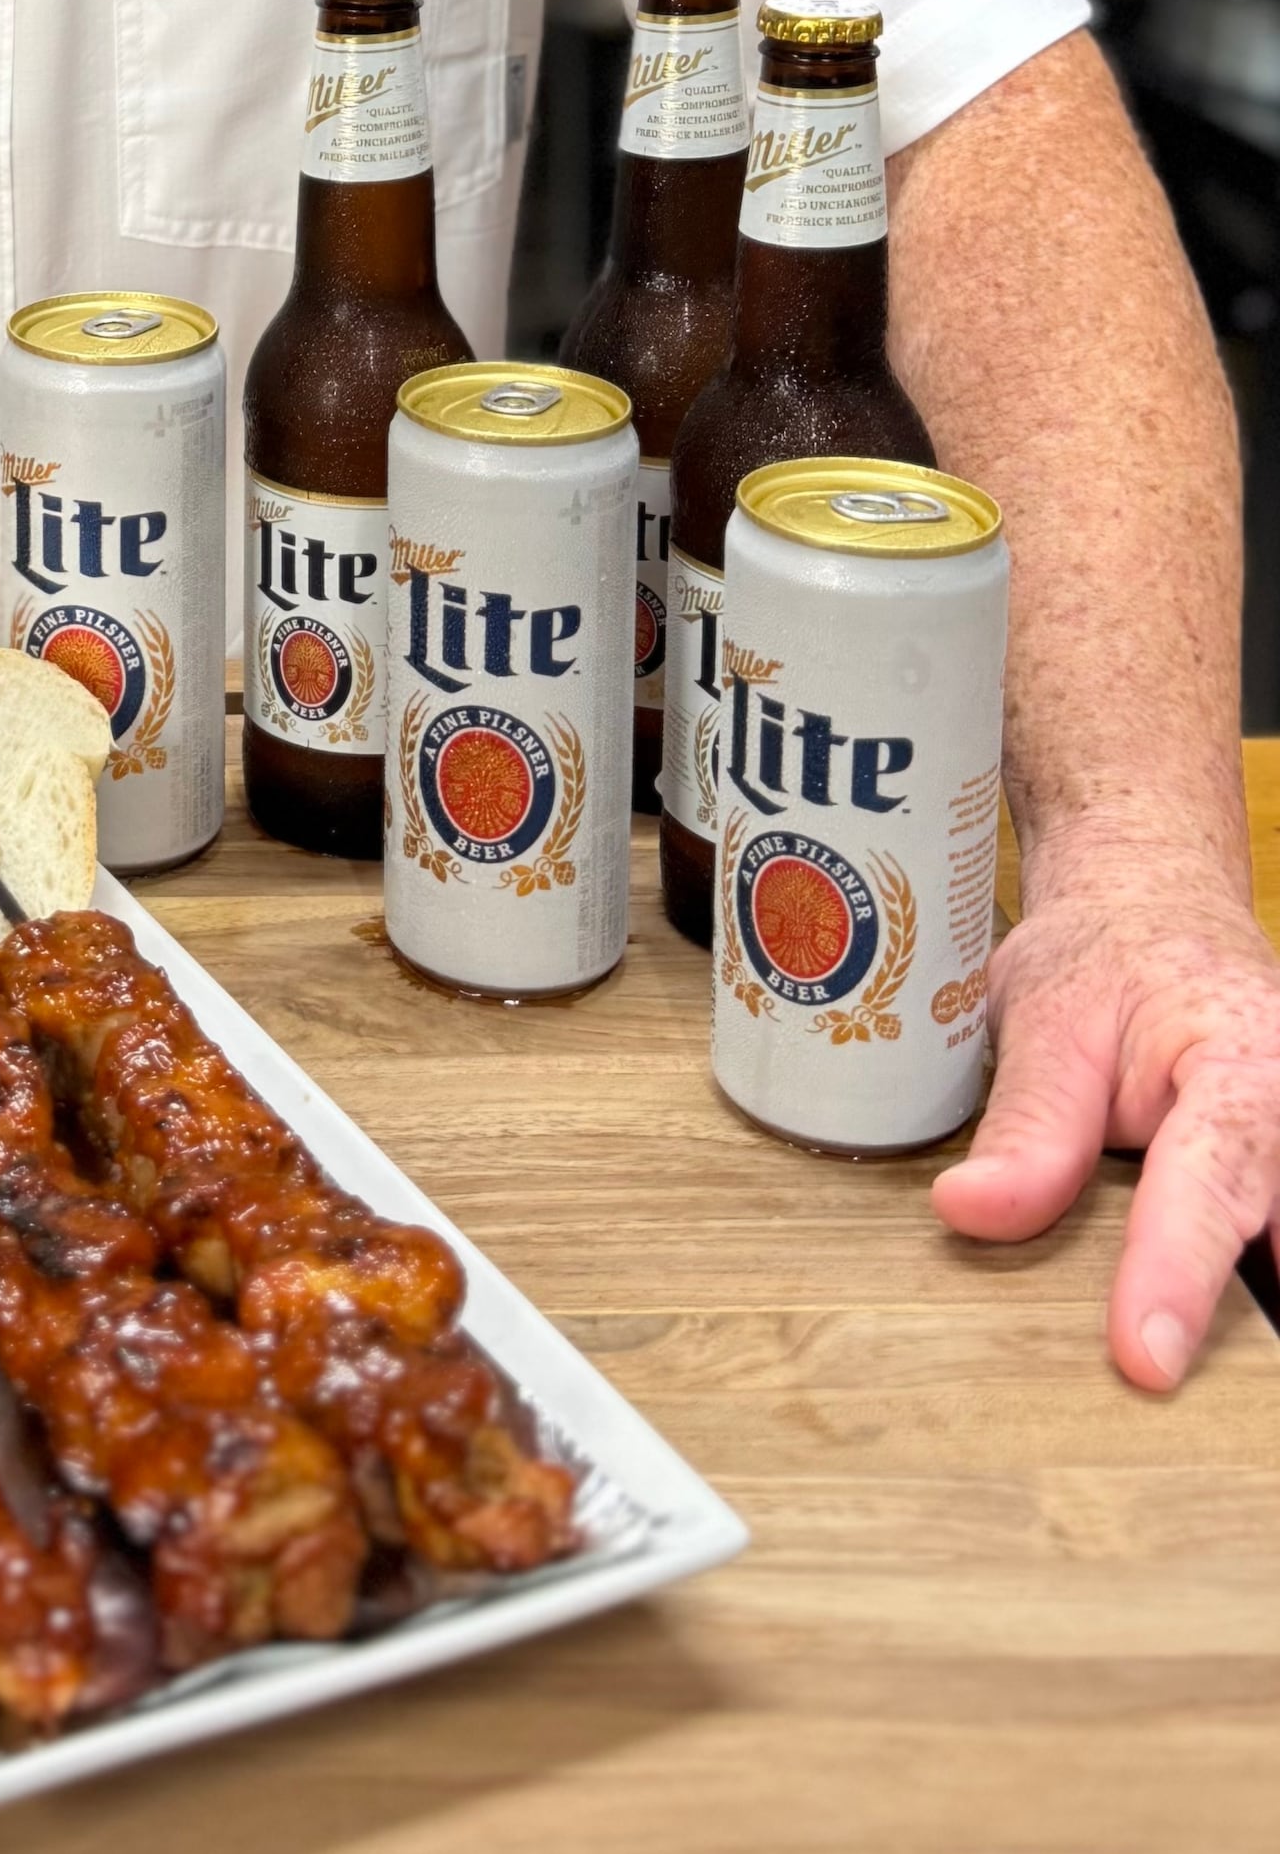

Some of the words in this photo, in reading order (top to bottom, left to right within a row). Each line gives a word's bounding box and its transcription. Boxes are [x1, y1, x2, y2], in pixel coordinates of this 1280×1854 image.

[319, 151, 377, 163] FREDRICK
[747, 122, 857, 184] Miller
[1, 449, 62, 489] Miller
[249, 496, 295, 525] Miller
[11, 477, 167, 595] Lite
[389, 529, 466, 580] Miller
[257, 517, 377, 611] Lite
[637, 586, 667, 627] LSNER
[675, 576, 724, 618] Mill
[33, 609, 69, 641] FINE
[75, 609, 140, 670] PILSNER
[276, 619, 300, 641] FINE
[303, 619, 349, 669] PILSNER
[403, 561, 581, 693] Lite
[272, 644, 281, 653] A
[722, 636, 784, 684] Miller
[291, 701, 327, 719] BEER
[430, 710, 472, 743] FINE
[424, 746, 437, 761] A
[478, 710, 550, 779] PILSNER
[727, 667, 914, 816] Lite
[453, 835, 515, 860] BEER
[746, 836, 787, 867] FINE
[741, 869, 753, 885] A
[794, 837, 872, 921] PILSNER
[766, 970, 831, 1000] BEER
